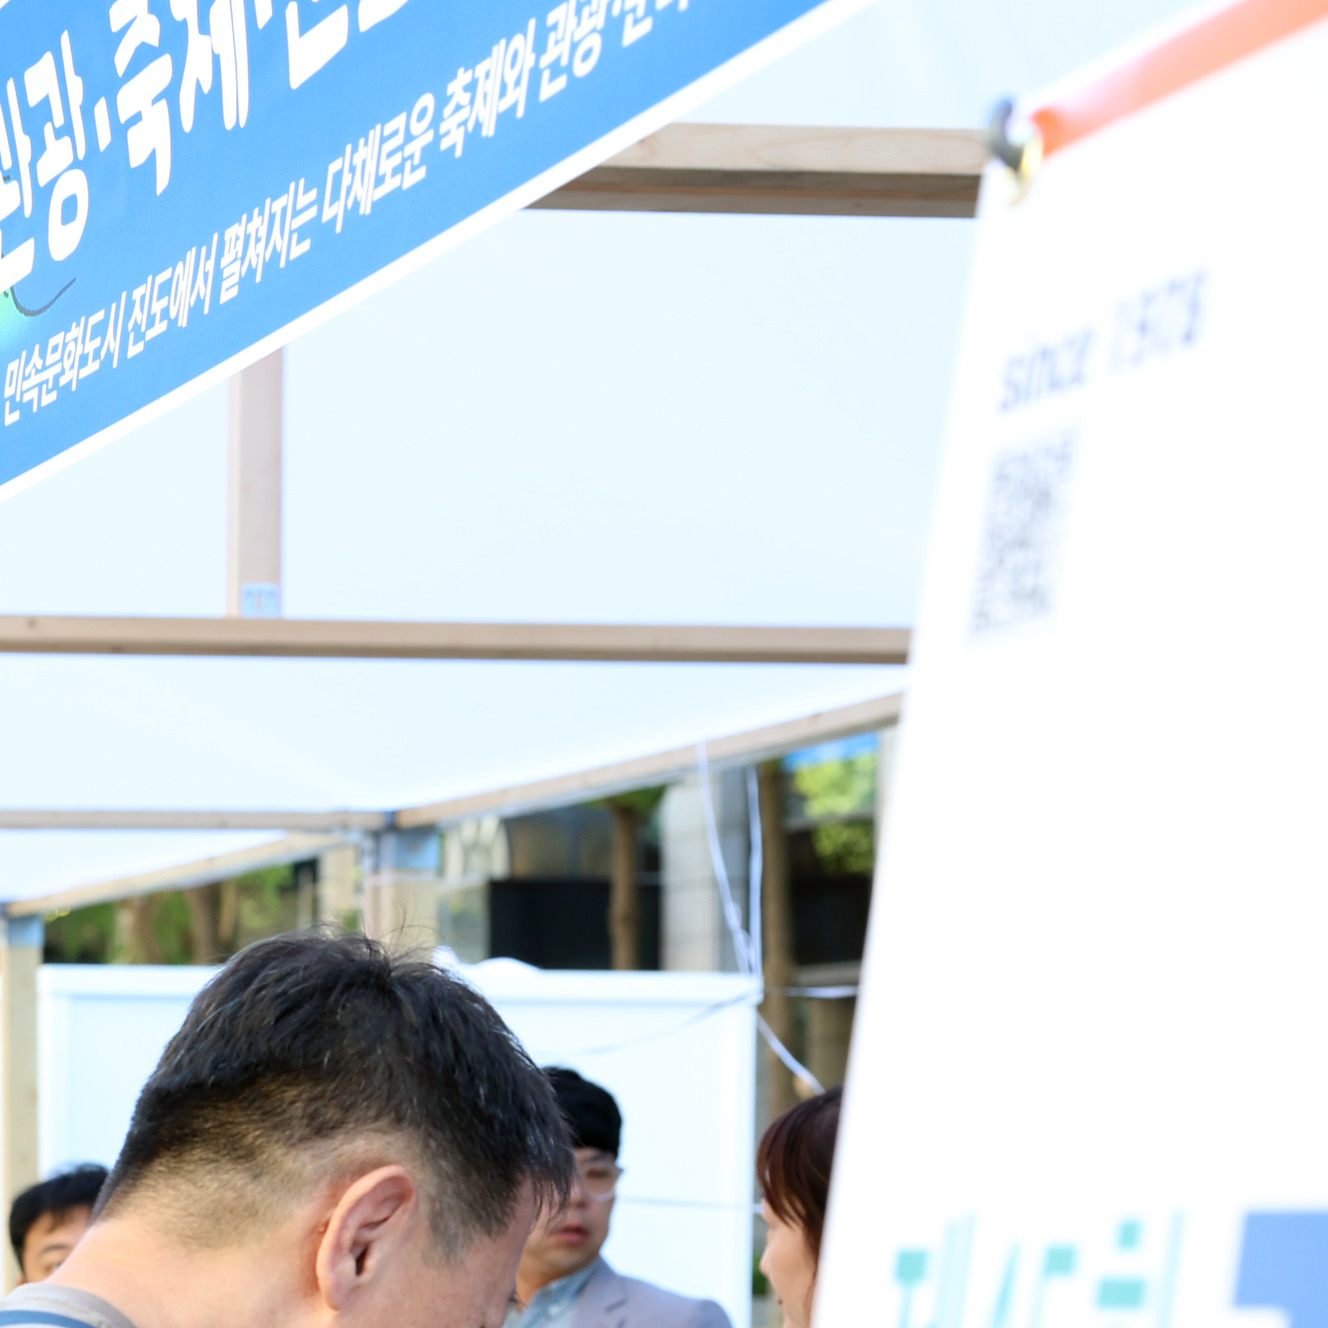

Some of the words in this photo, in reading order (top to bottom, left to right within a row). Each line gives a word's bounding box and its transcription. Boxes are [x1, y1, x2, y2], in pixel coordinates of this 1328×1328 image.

[4, 290, 127, 427] 민속문화도시
[127, 232, 219, 359] 진도에서
[219, 177, 318, 304] 펼쳐지는
[321, 93, 435, 234] 다채로운
[439, 17, 536, 158] 축제와
